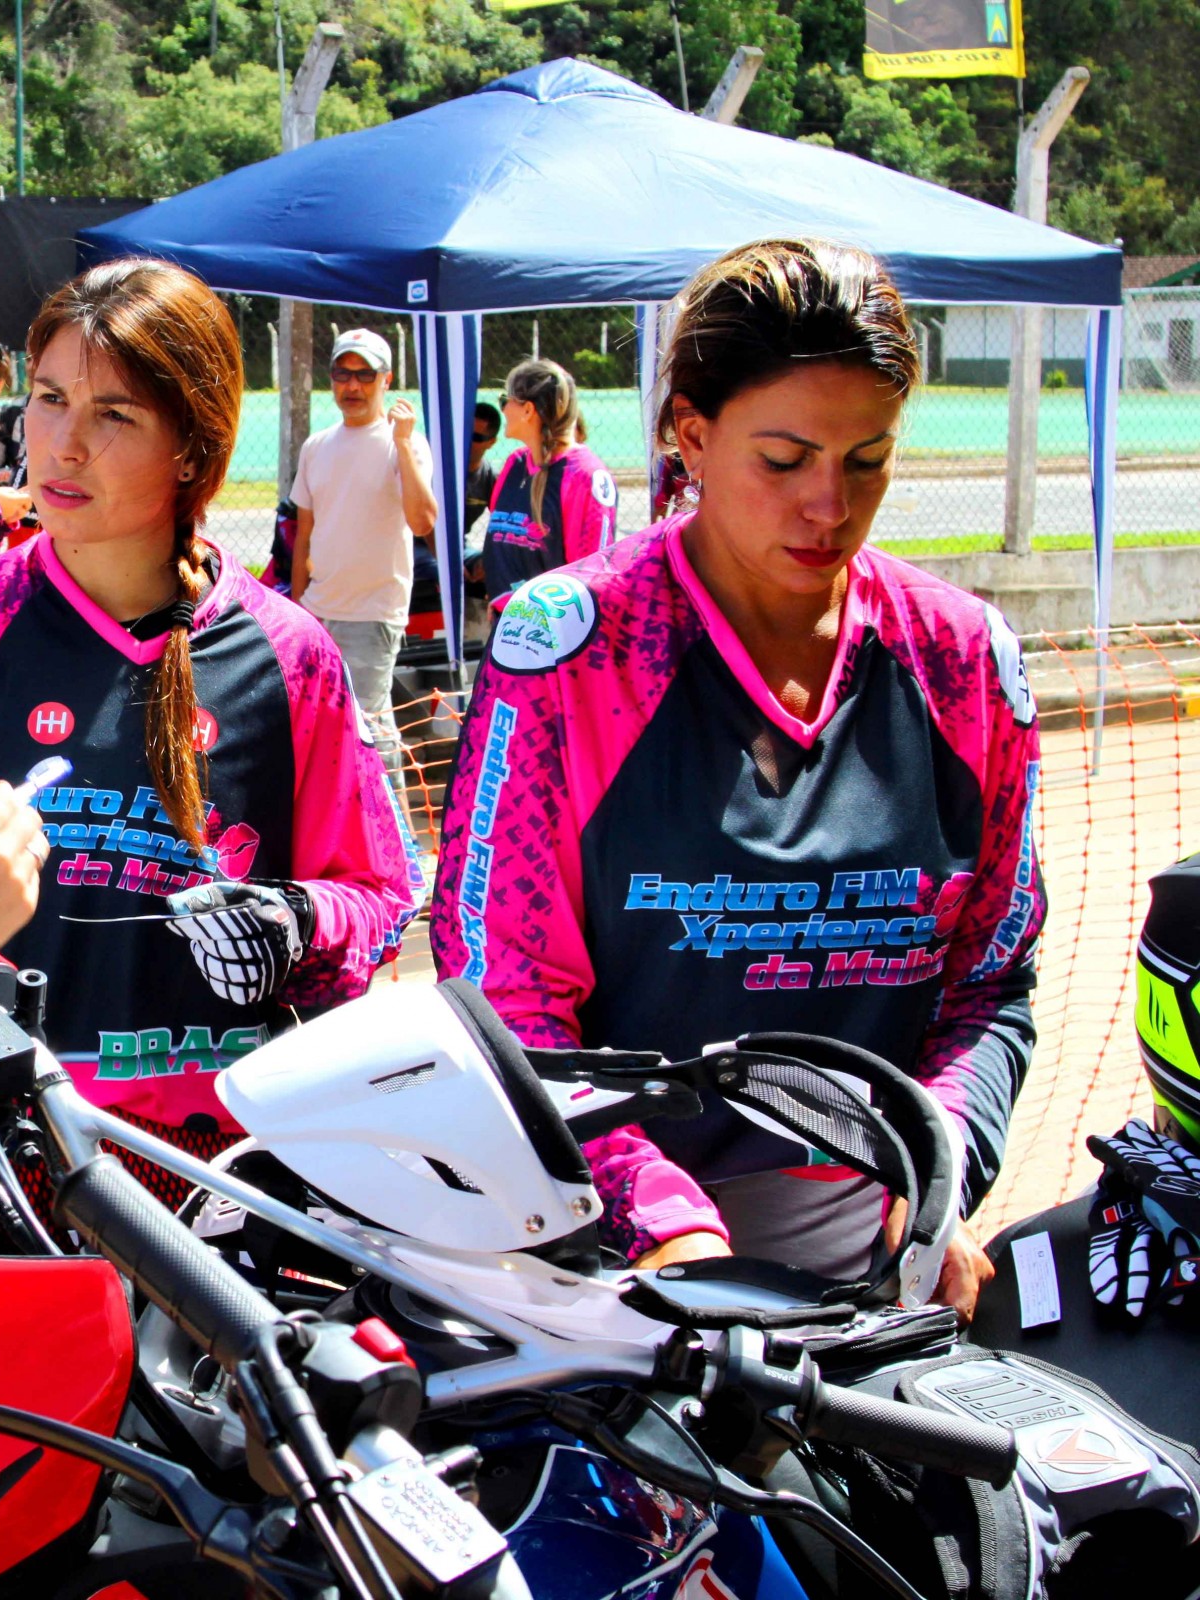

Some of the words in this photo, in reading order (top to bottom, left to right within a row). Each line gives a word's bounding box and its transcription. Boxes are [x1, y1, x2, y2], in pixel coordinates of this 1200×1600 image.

[471, 698, 518, 840] Enduro
[42, 818, 220, 874] perience
[57, 853, 113, 887] da
[459, 835, 494, 917] FIM
[624, 873, 820, 911] Enduro
[826, 868, 921, 909] FIM
[668, 913, 937, 958] Xperience
[992, 885, 1035, 955] FIM
[743, 954, 813, 990] da
